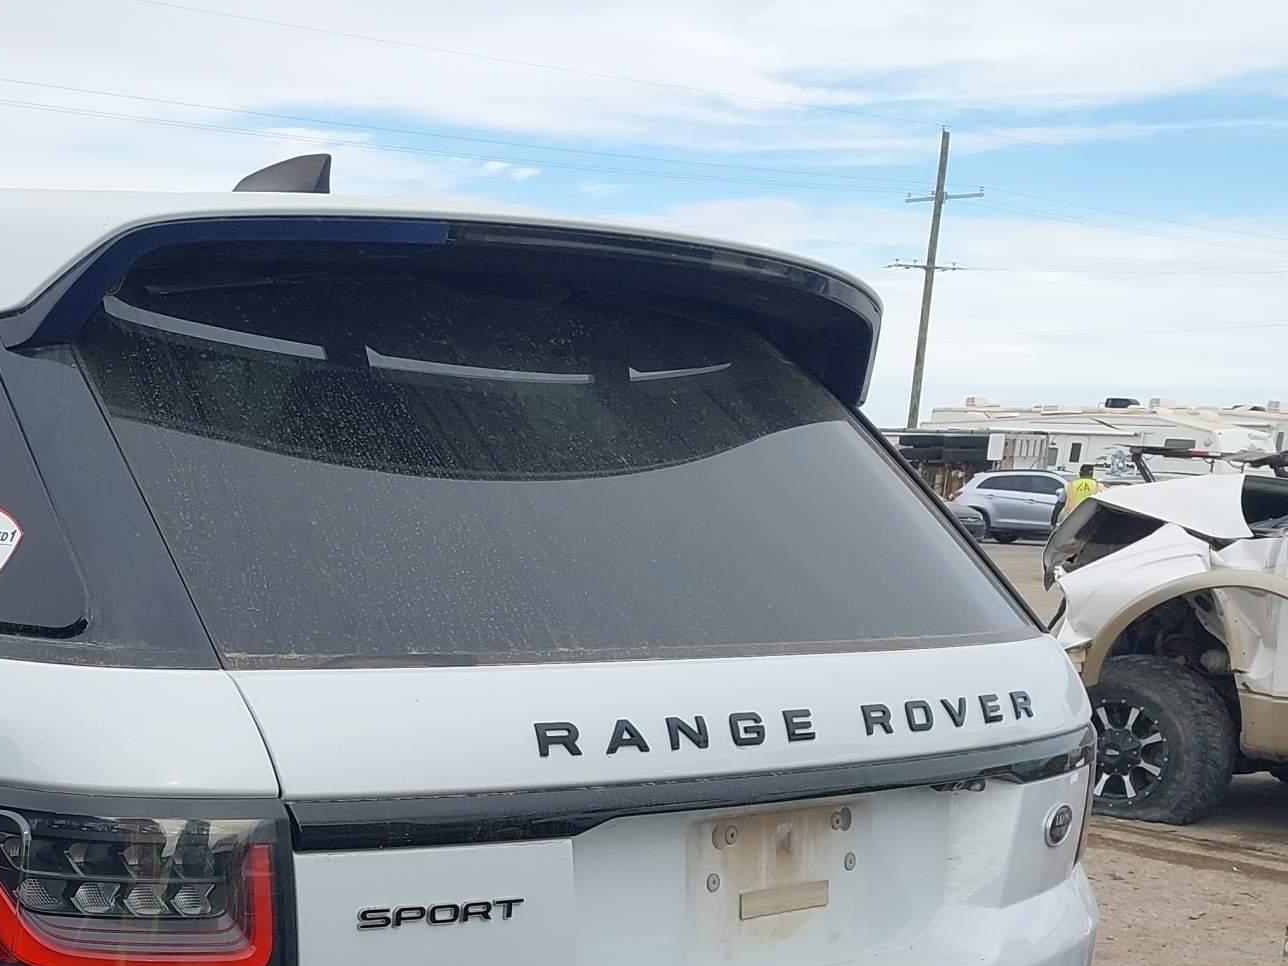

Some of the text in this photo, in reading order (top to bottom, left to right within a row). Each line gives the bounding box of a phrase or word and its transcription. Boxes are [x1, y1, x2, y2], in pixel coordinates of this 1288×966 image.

[10, 529, 17, 542] 1
[534, 690, 1034, 758] RANGE ROVER
[357, 897, 526, 931] SPORT
